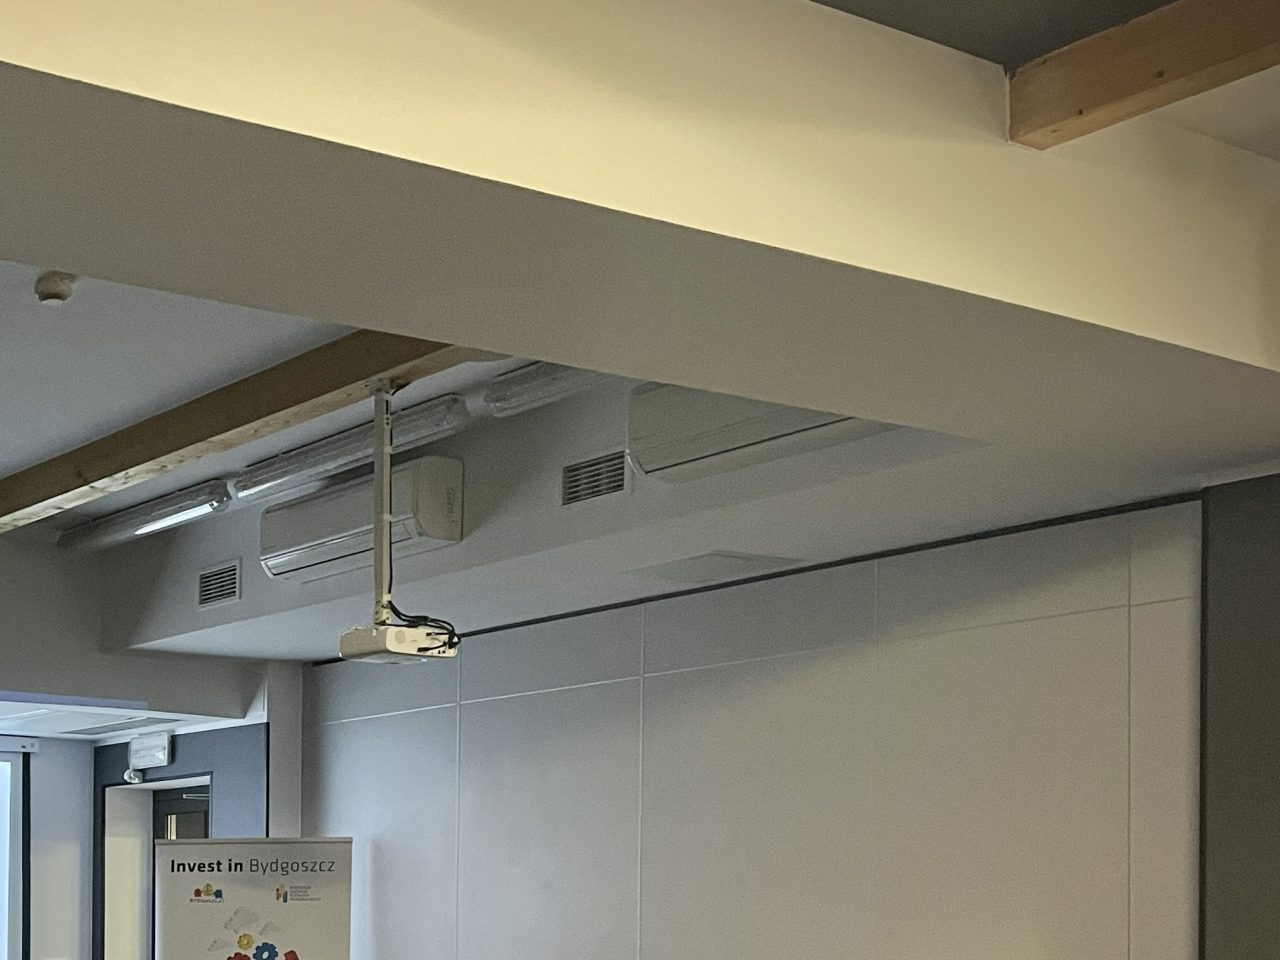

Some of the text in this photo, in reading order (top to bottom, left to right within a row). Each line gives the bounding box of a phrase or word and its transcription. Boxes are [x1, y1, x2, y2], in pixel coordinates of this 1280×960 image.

[170, 858, 335, 876] Invest in Bydgoszcz
